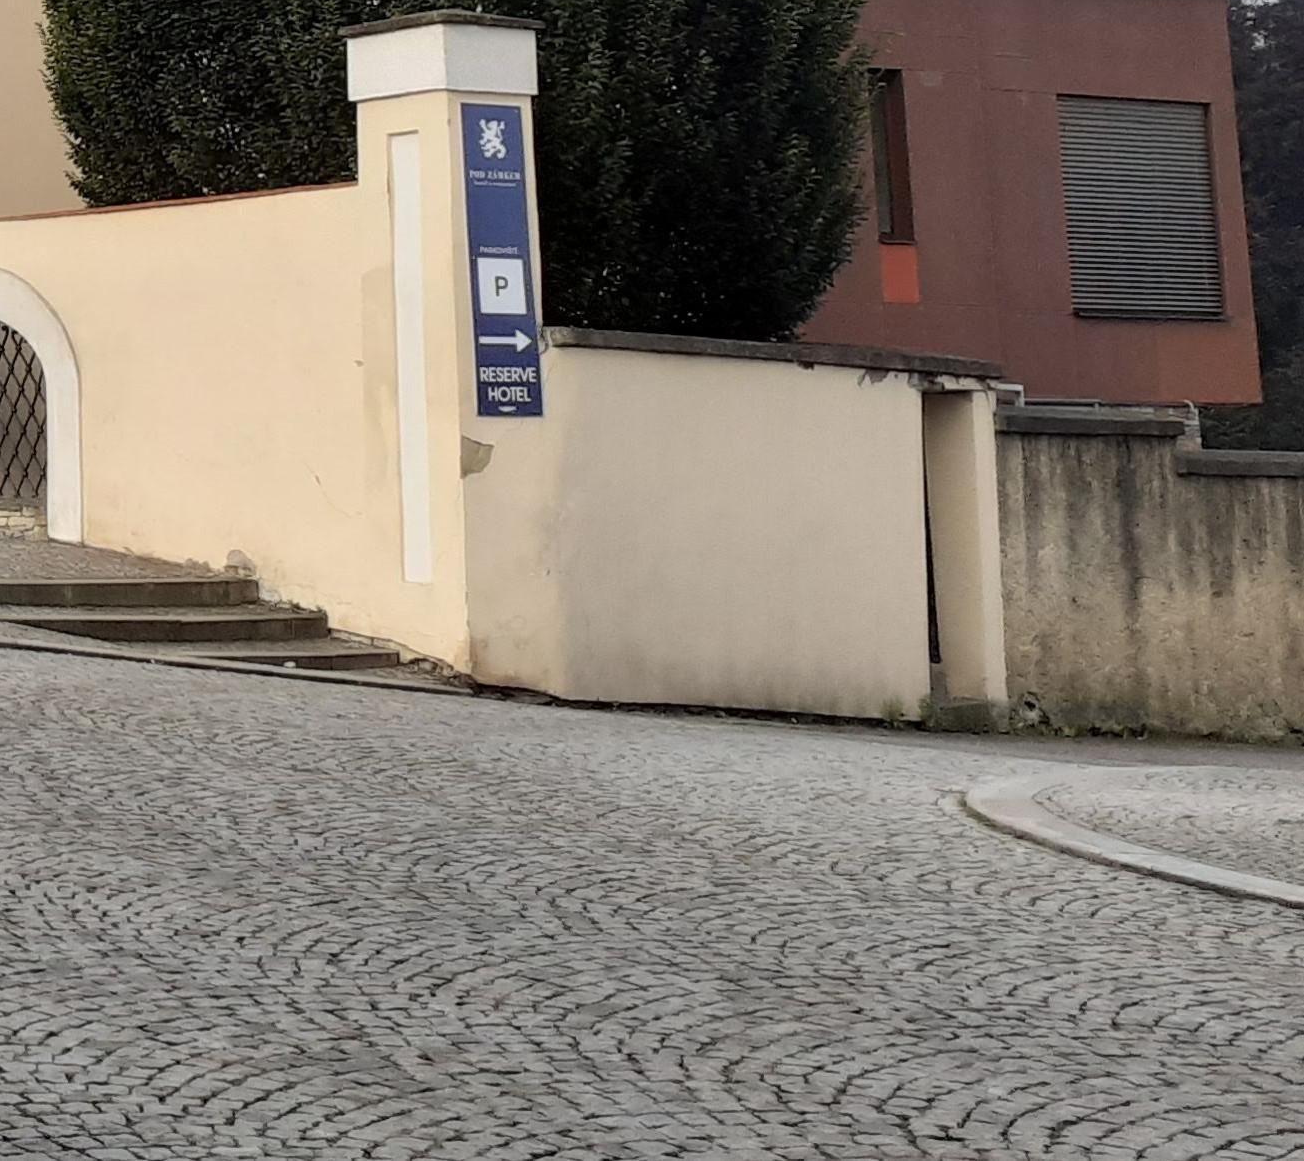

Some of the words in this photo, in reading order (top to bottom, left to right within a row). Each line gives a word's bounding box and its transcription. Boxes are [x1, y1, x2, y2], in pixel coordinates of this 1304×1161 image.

[469, 170, 485, 179] POD
[494, 276, 509, 297] P
[479, 367, 537, 382] RESERVE
[488, 386, 531, 402] HOTEL
